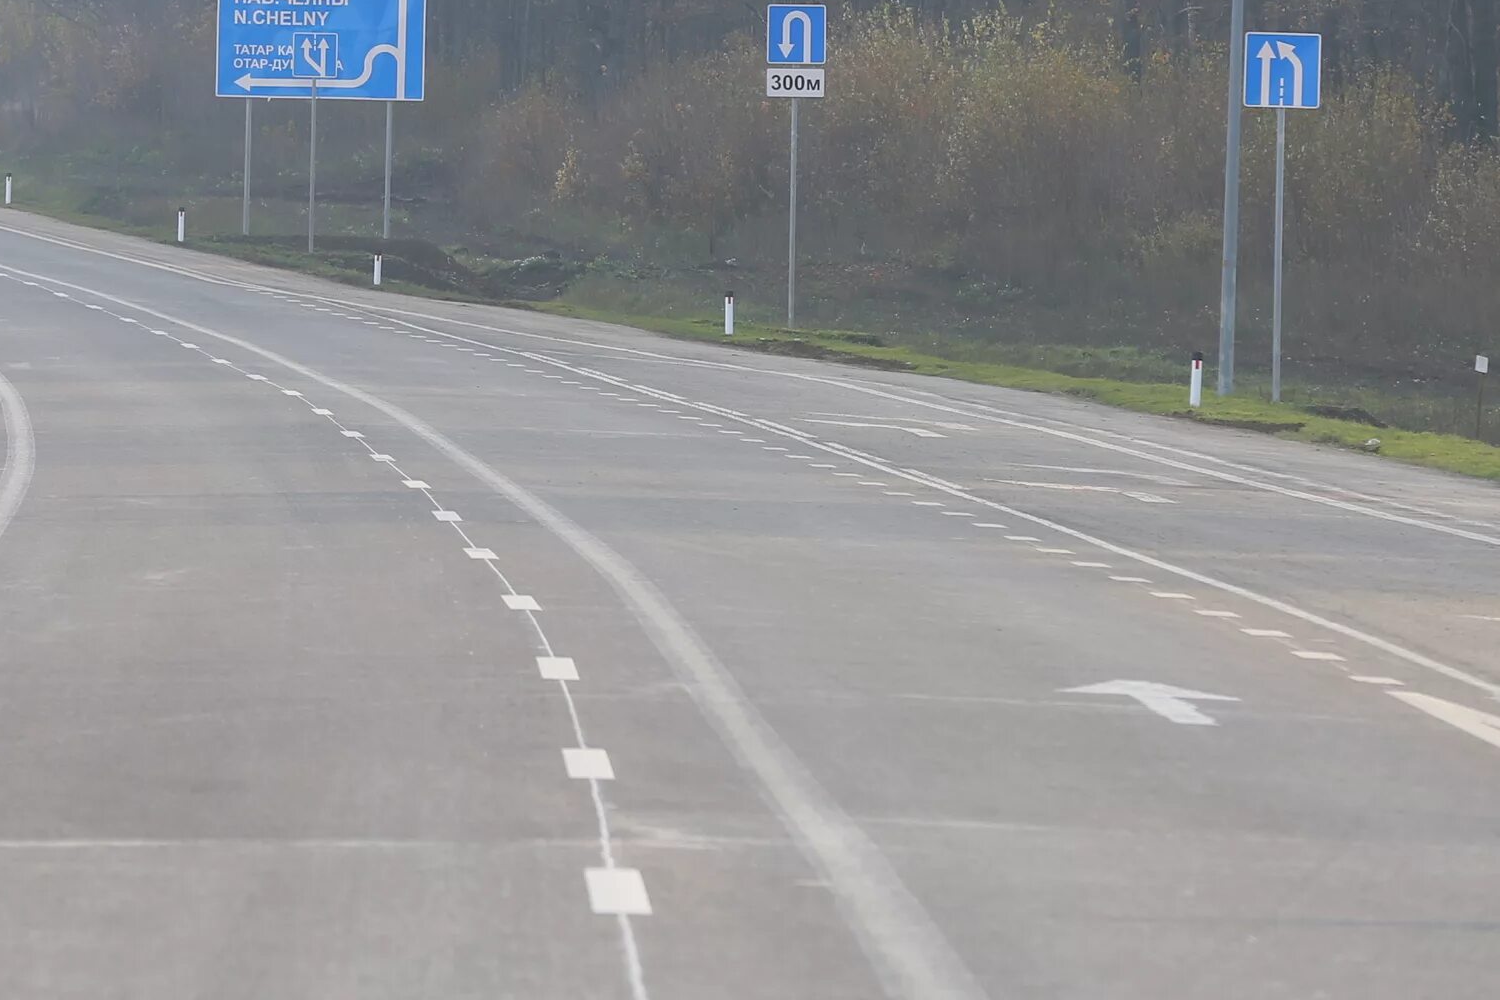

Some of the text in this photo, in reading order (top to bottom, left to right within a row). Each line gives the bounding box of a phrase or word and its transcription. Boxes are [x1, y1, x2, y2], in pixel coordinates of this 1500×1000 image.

[234, 9, 329, 26] N.CHELNY
[233, 44, 294, 56] ТАТАР КА
[771, 74, 820, 90] 300м
